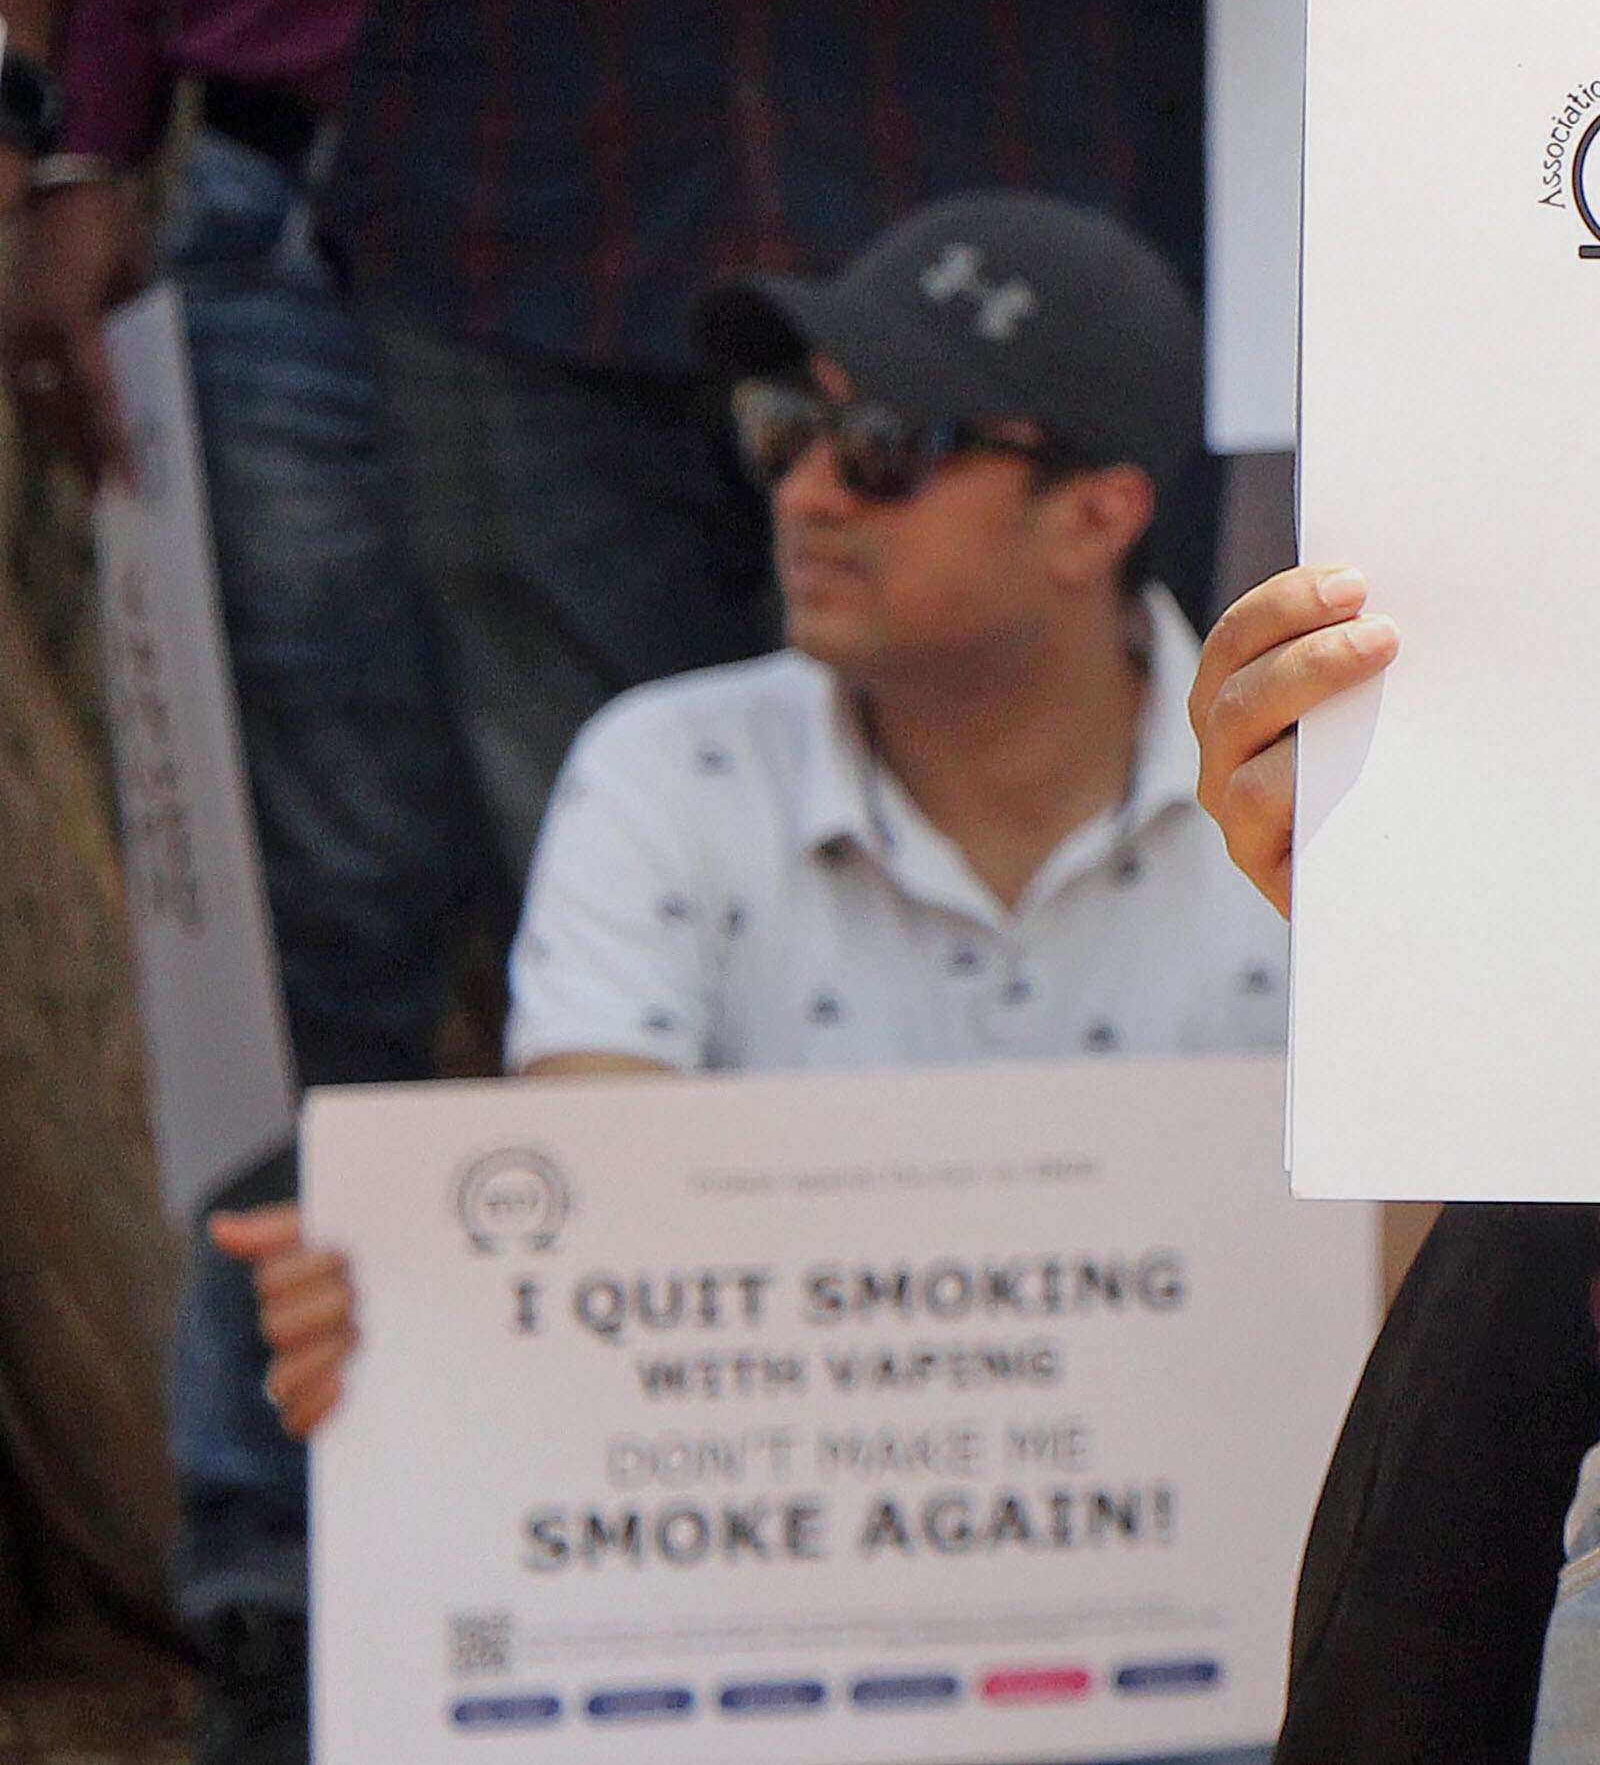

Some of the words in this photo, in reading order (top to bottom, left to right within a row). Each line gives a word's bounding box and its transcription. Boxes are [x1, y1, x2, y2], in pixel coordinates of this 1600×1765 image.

[513, 1277, 539, 1334] I
[571, 1268, 773, 1344] QUIT
[804, 1255, 1186, 1323] SMOKING
[639, 1353, 804, 1396] WITH
[827, 1346, 1059, 1391] VAPING
[526, 1496, 821, 1569] SMOKE
[861, 1487, 1173, 1553] AGAIN!
